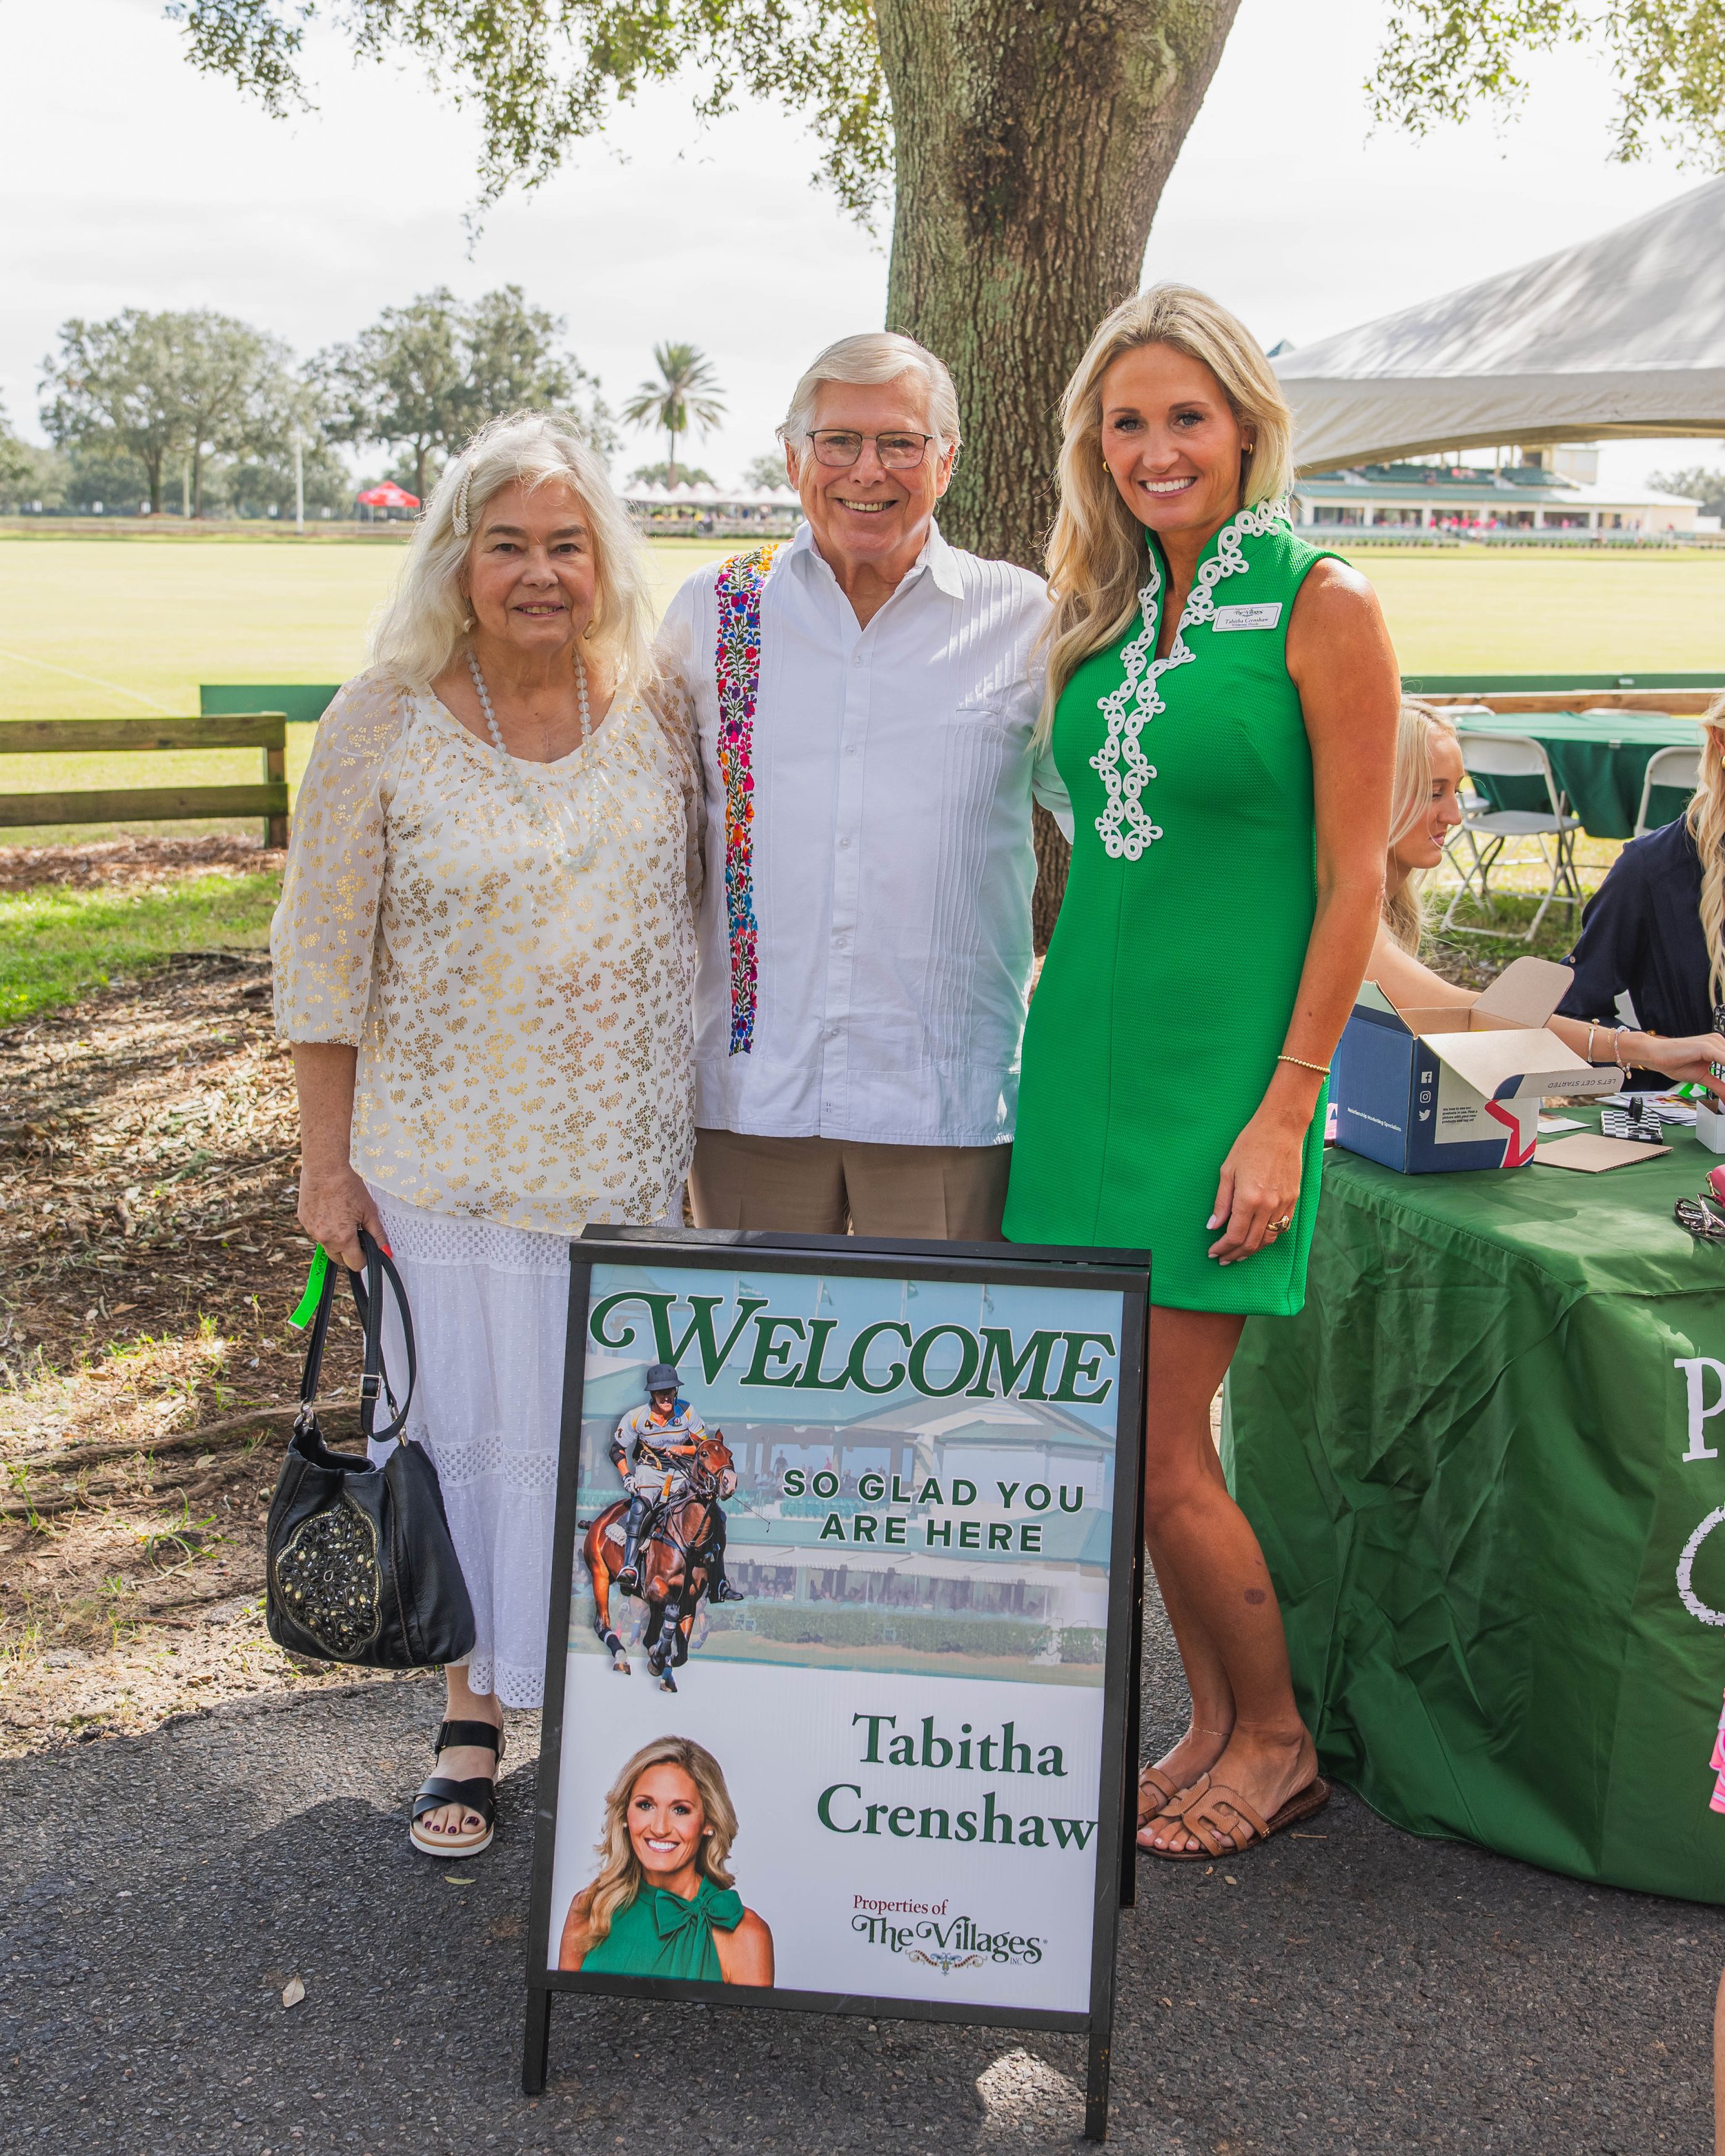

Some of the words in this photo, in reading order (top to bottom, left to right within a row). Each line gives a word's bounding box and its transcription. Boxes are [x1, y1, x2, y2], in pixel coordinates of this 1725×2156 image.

[1347, 1107, 1367, 1119] Relationship
[1367, 1114, 1383, 1126] Marketing
[1383, 1121, 1401, 1132] Specialists
[590, 1291, 1117, 1403] WELCOME
[782, 1469, 840, 1499] SO
[858, 1473, 978, 1507] GLAD
[996, 1481, 1085, 1513] YOU
[820, 1513, 907, 1545] ARE
[925, 1519, 1043, 1554] HERE
[851, 1712, 1068, 1777] Tabitha
[817, 1783, 1098, 1850] Crenshaw
[853, 1895, 928, 1915] Properties
[931, 1899, 949, 1915] of
[851, 1915, 914, 1952] The
